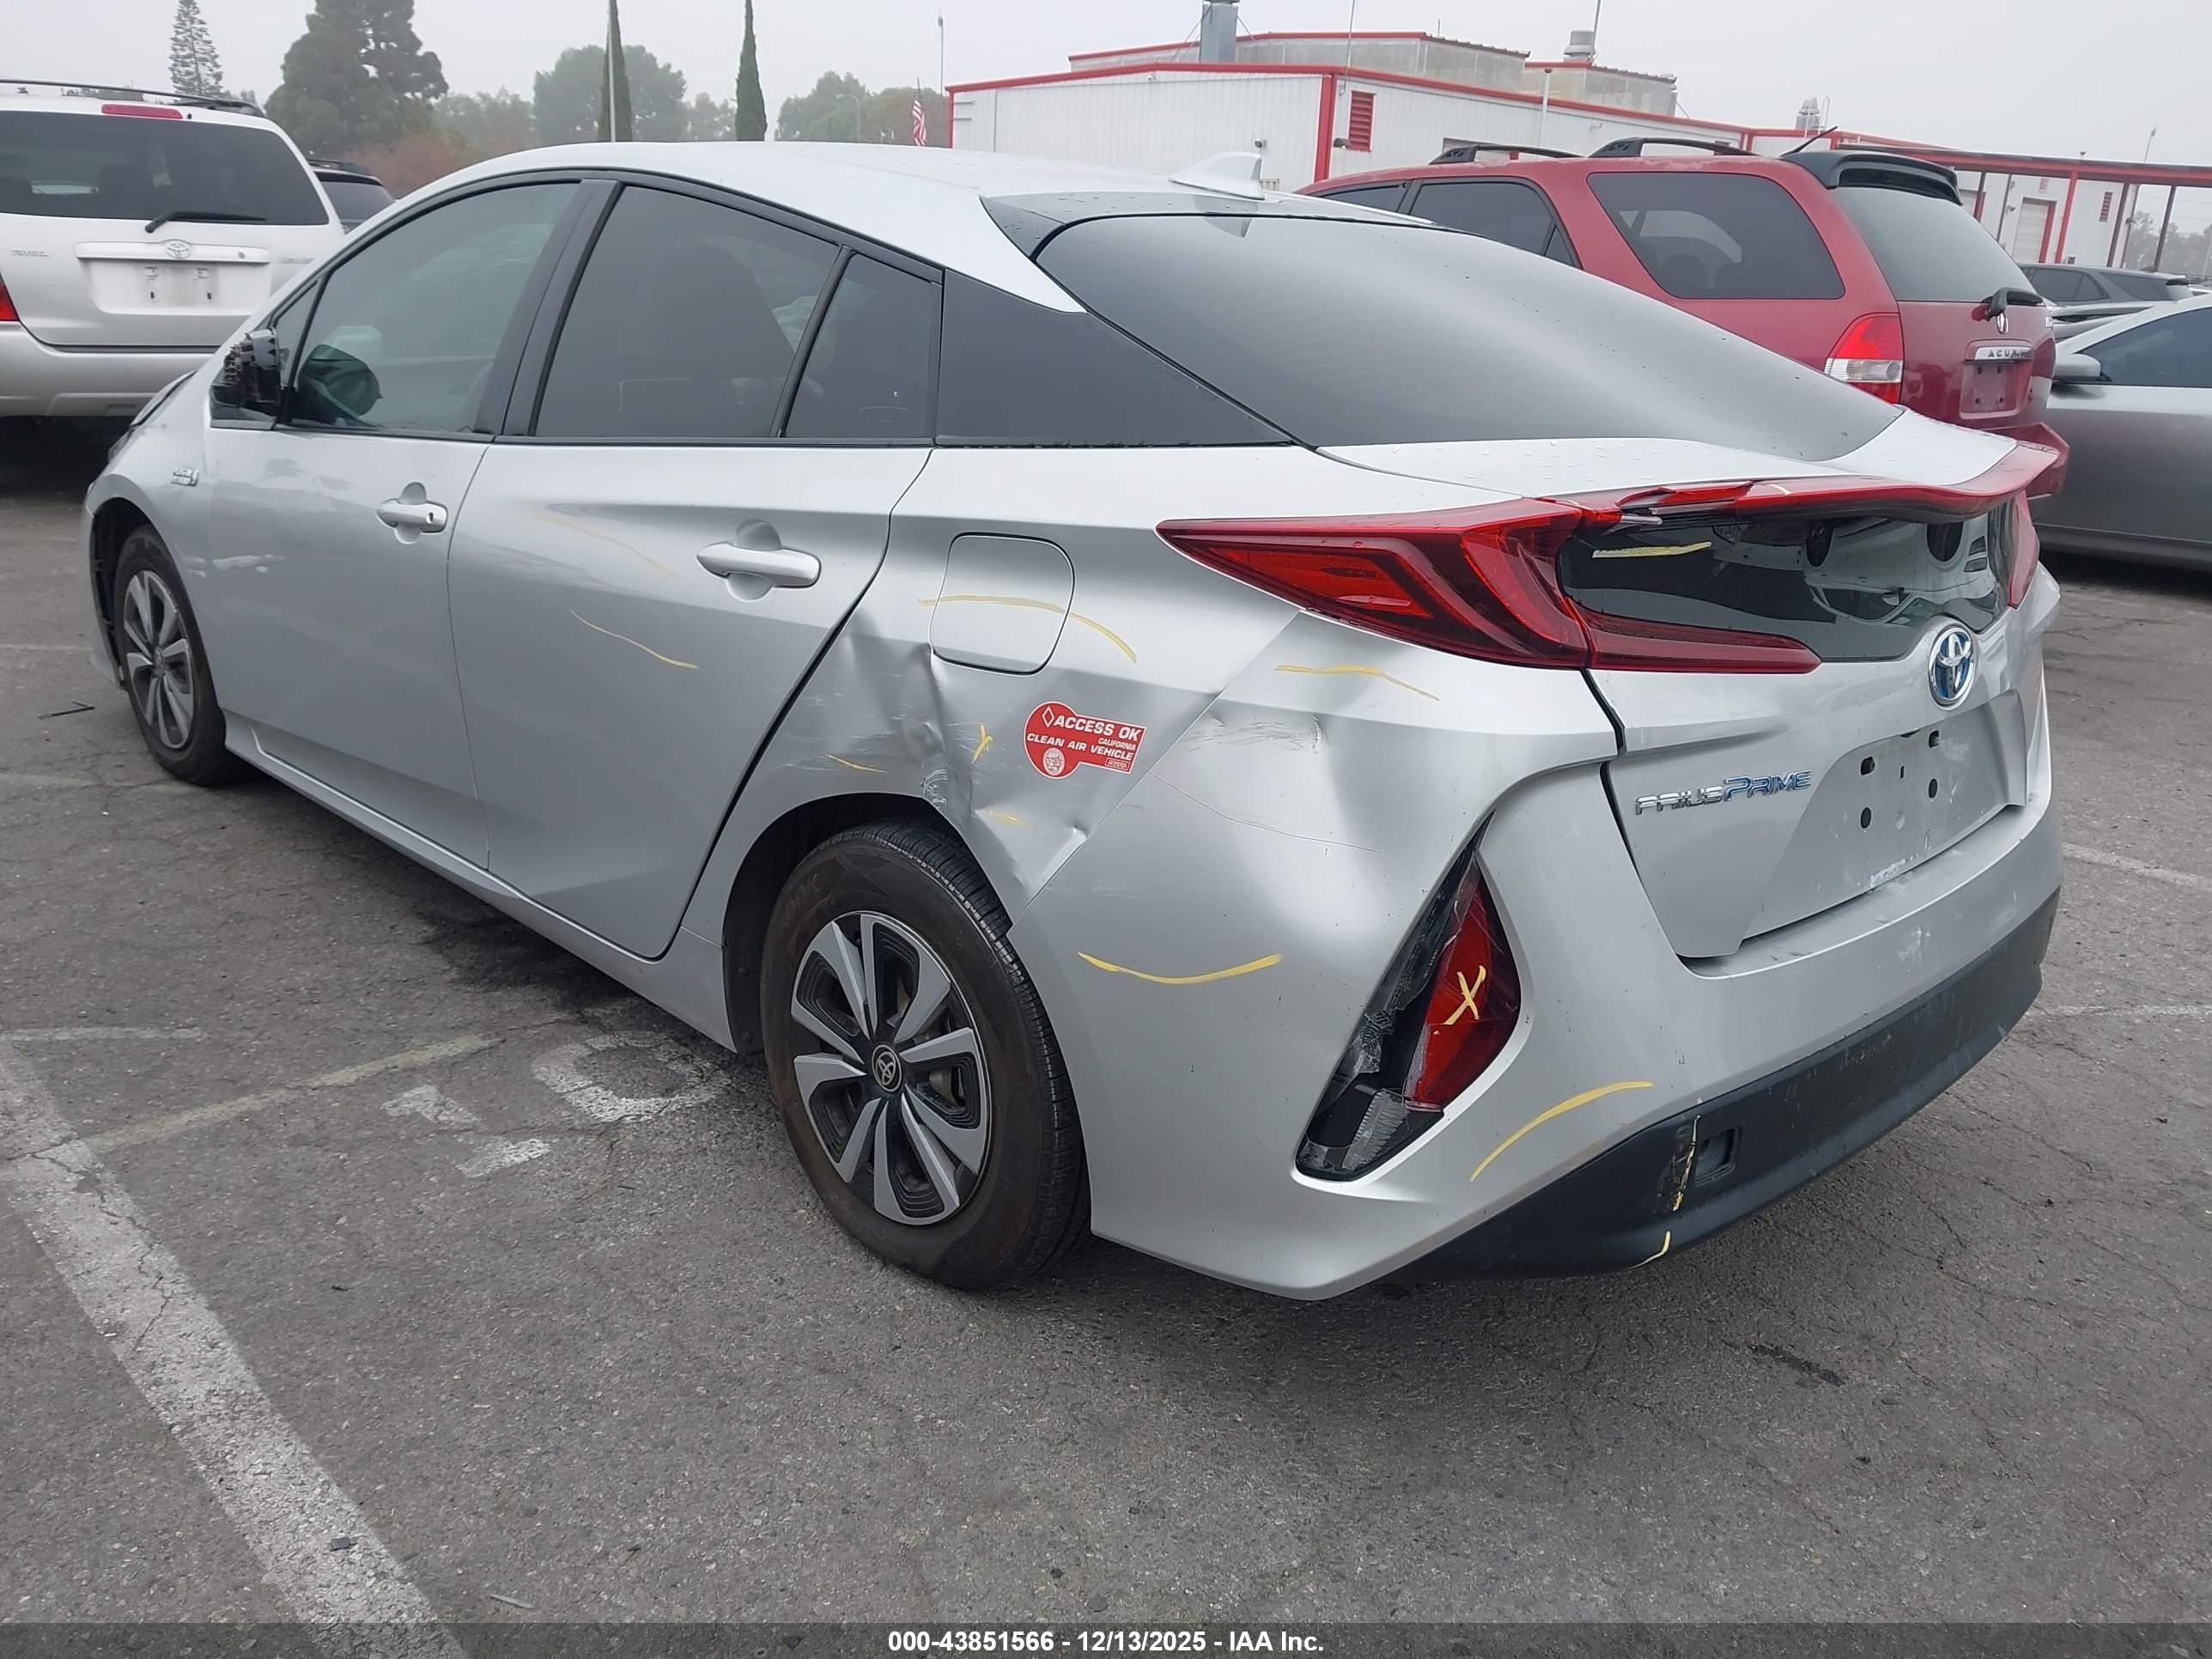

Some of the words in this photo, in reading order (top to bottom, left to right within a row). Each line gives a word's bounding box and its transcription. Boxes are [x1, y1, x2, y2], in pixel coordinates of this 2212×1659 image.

[1054, 714, 1115, 736] ACCESS
[1118, 726, 1142, 742] OK
[1027, 733, 1065, 746] CLEAN
[1067, 740, 1087, 751] AIR
[1091, 744, 1134, 761] VEHICLE
[1098, 738, 1136, 750] CALIFORNIA
